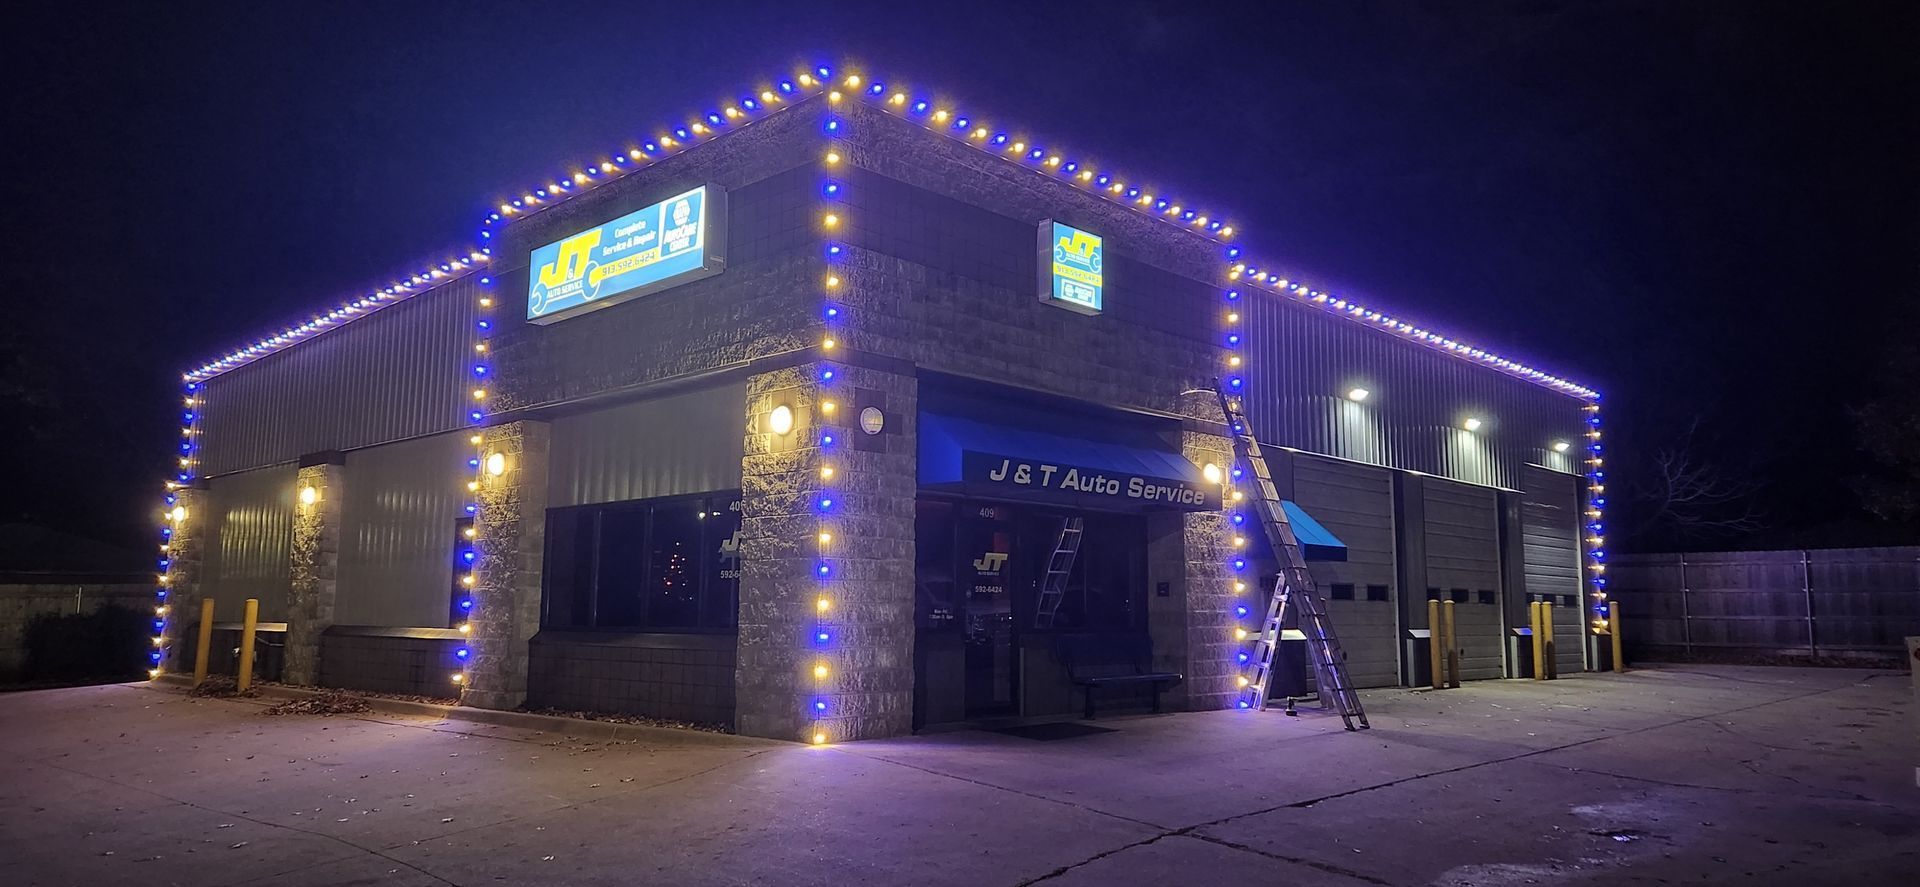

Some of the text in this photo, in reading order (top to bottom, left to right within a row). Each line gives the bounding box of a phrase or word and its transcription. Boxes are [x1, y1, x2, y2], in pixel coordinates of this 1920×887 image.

[614, 220, 647, 238] Complete
[602, 230, 656, 256] Service & Repair
[602, 251, 655, 277] 913.592.6424
[547, 280, 584, 299] AUTO SERVICE
[989, 459, 1206, 506] J & T Auto Service
[979, 507, 995, 519] 409
[975, 585, 1003, 593] 592-6424
